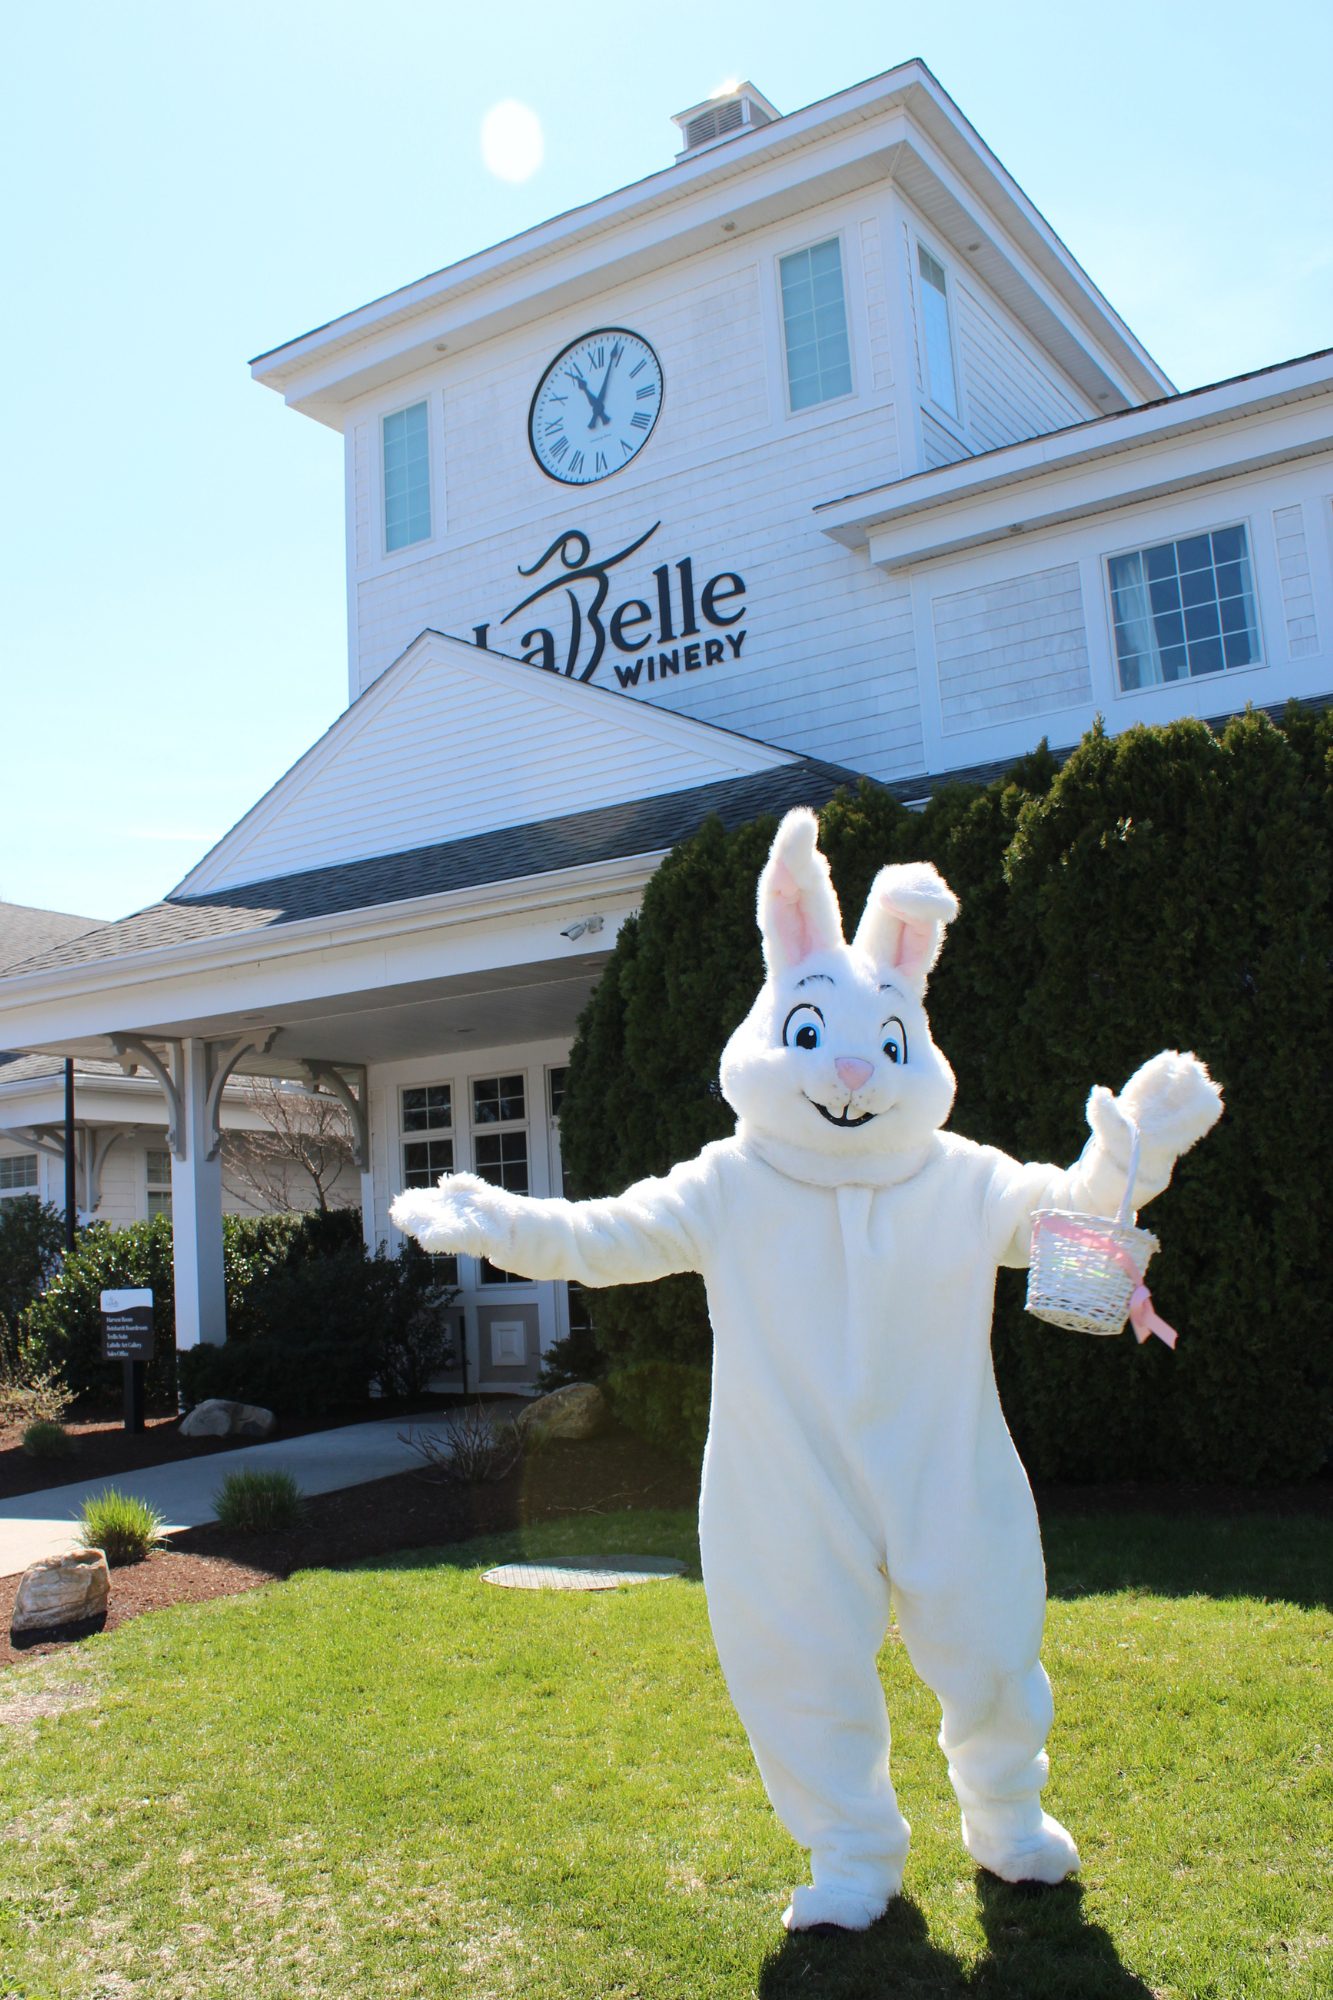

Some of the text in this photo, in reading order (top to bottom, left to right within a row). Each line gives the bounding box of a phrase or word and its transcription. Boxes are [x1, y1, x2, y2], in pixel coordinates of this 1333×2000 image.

[629, 359, 647, 379] II
[549, 392, 569, 406] X
[636, 384, 656, 400] III
[620, 439, 633, 457] V
[614, 630, 747, 688] WINERY
